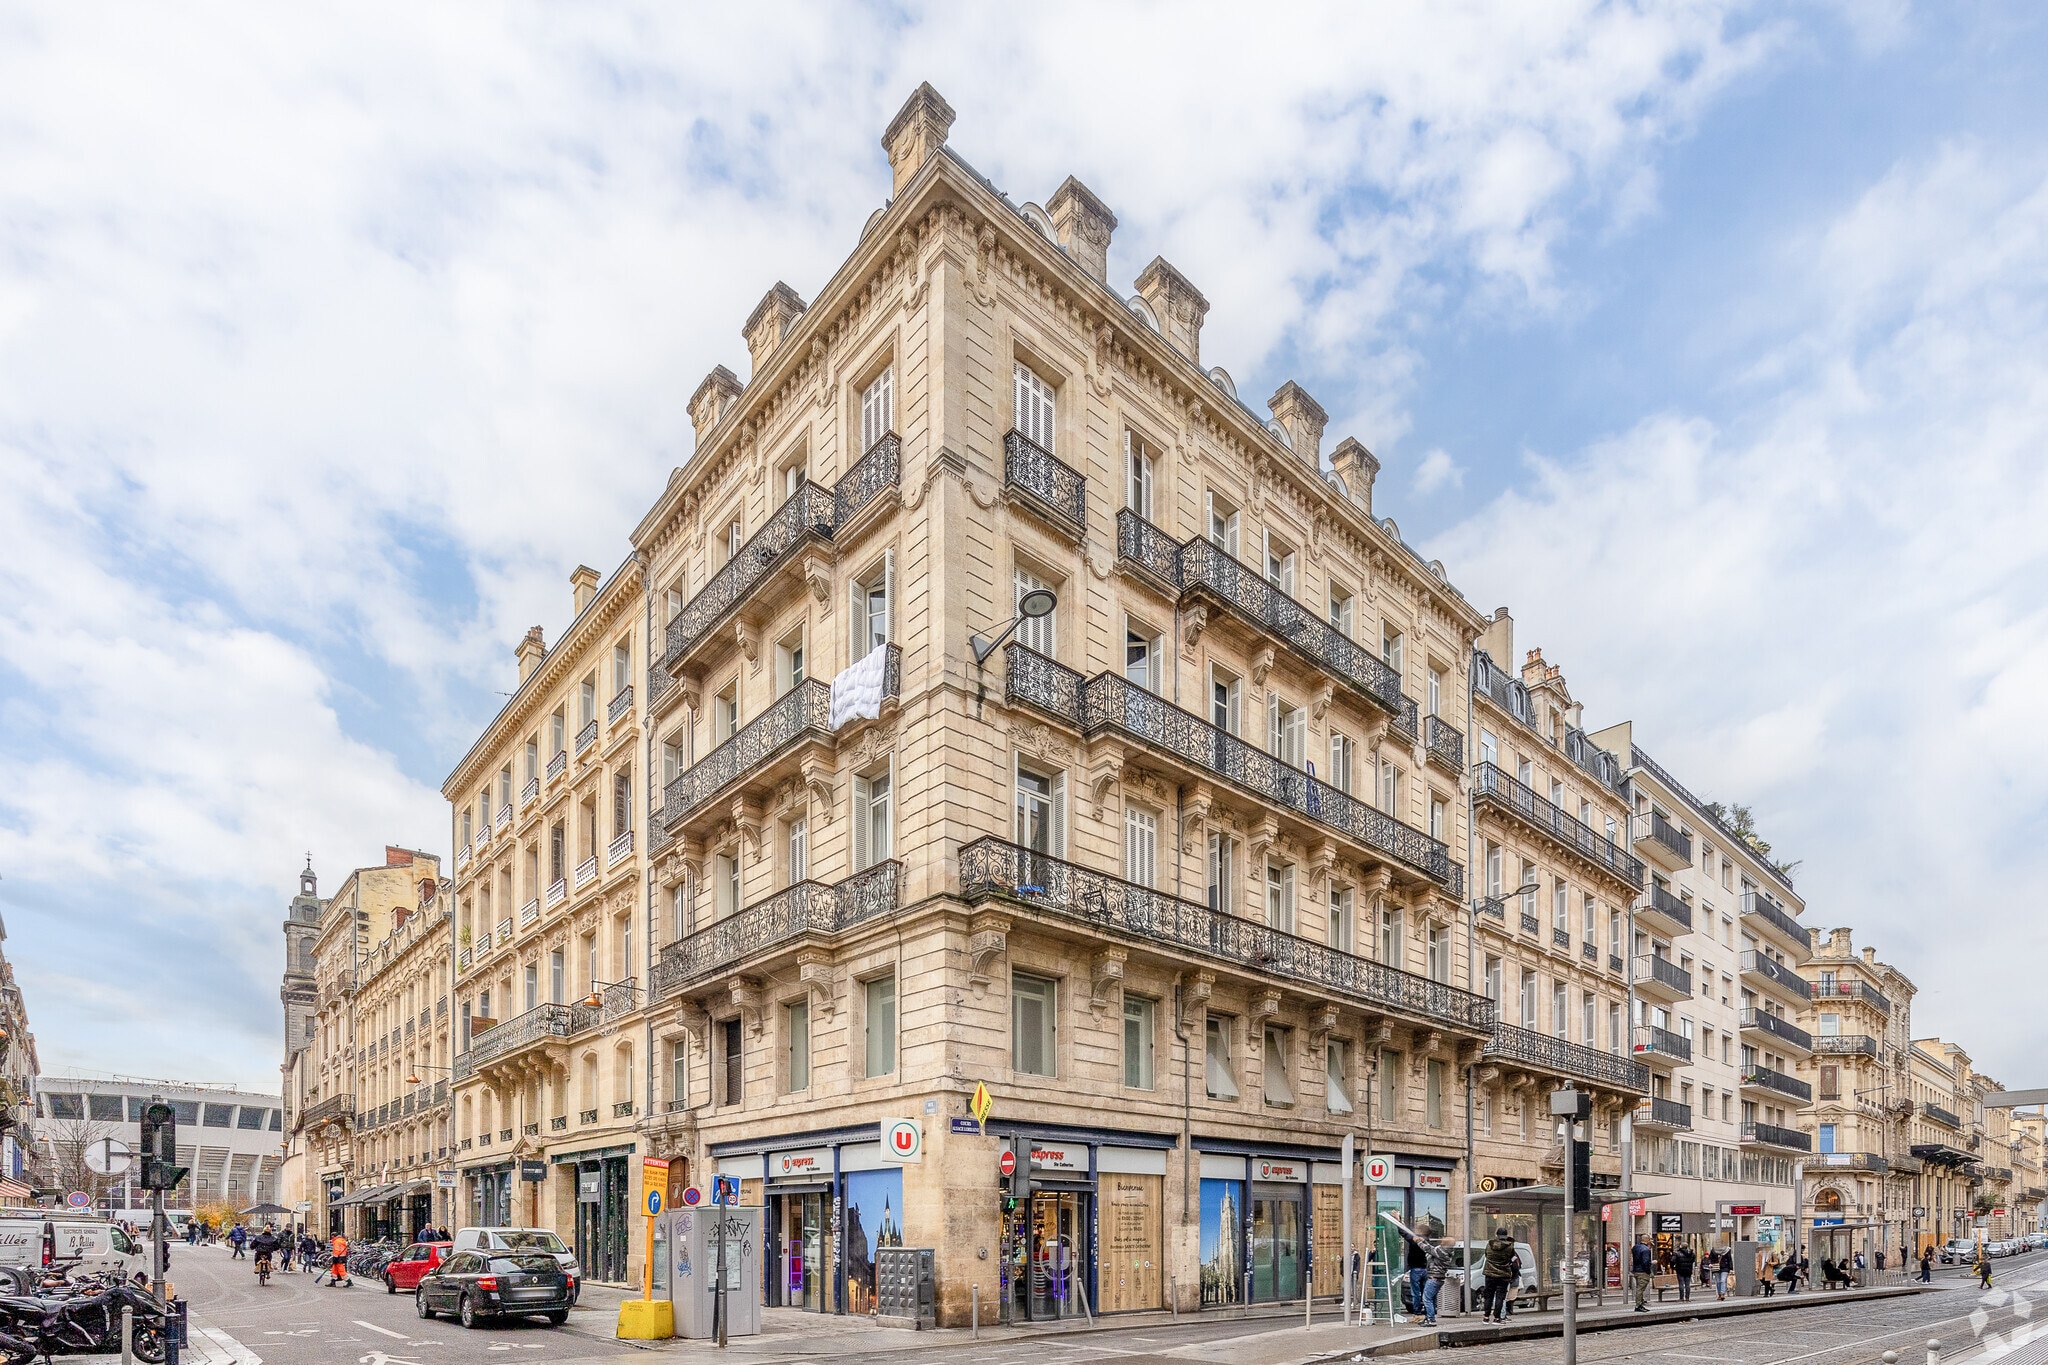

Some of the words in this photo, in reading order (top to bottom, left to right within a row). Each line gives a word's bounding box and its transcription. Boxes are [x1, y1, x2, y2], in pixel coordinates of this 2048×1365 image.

[980, 1101, 991, 1123] PRESSE
[896, 1131, 912, 1150] U
[1031, 1149, 1064, 1161] express
[644, 1158, 669, 1168] ATTENTION
[791, 1157, 814, 1168] express
[1271, 1166, 1293, 1176] express
[1371, 1164, 1383, 1177] U
[1117, 1182, 1144, 1191] Bienvenue
